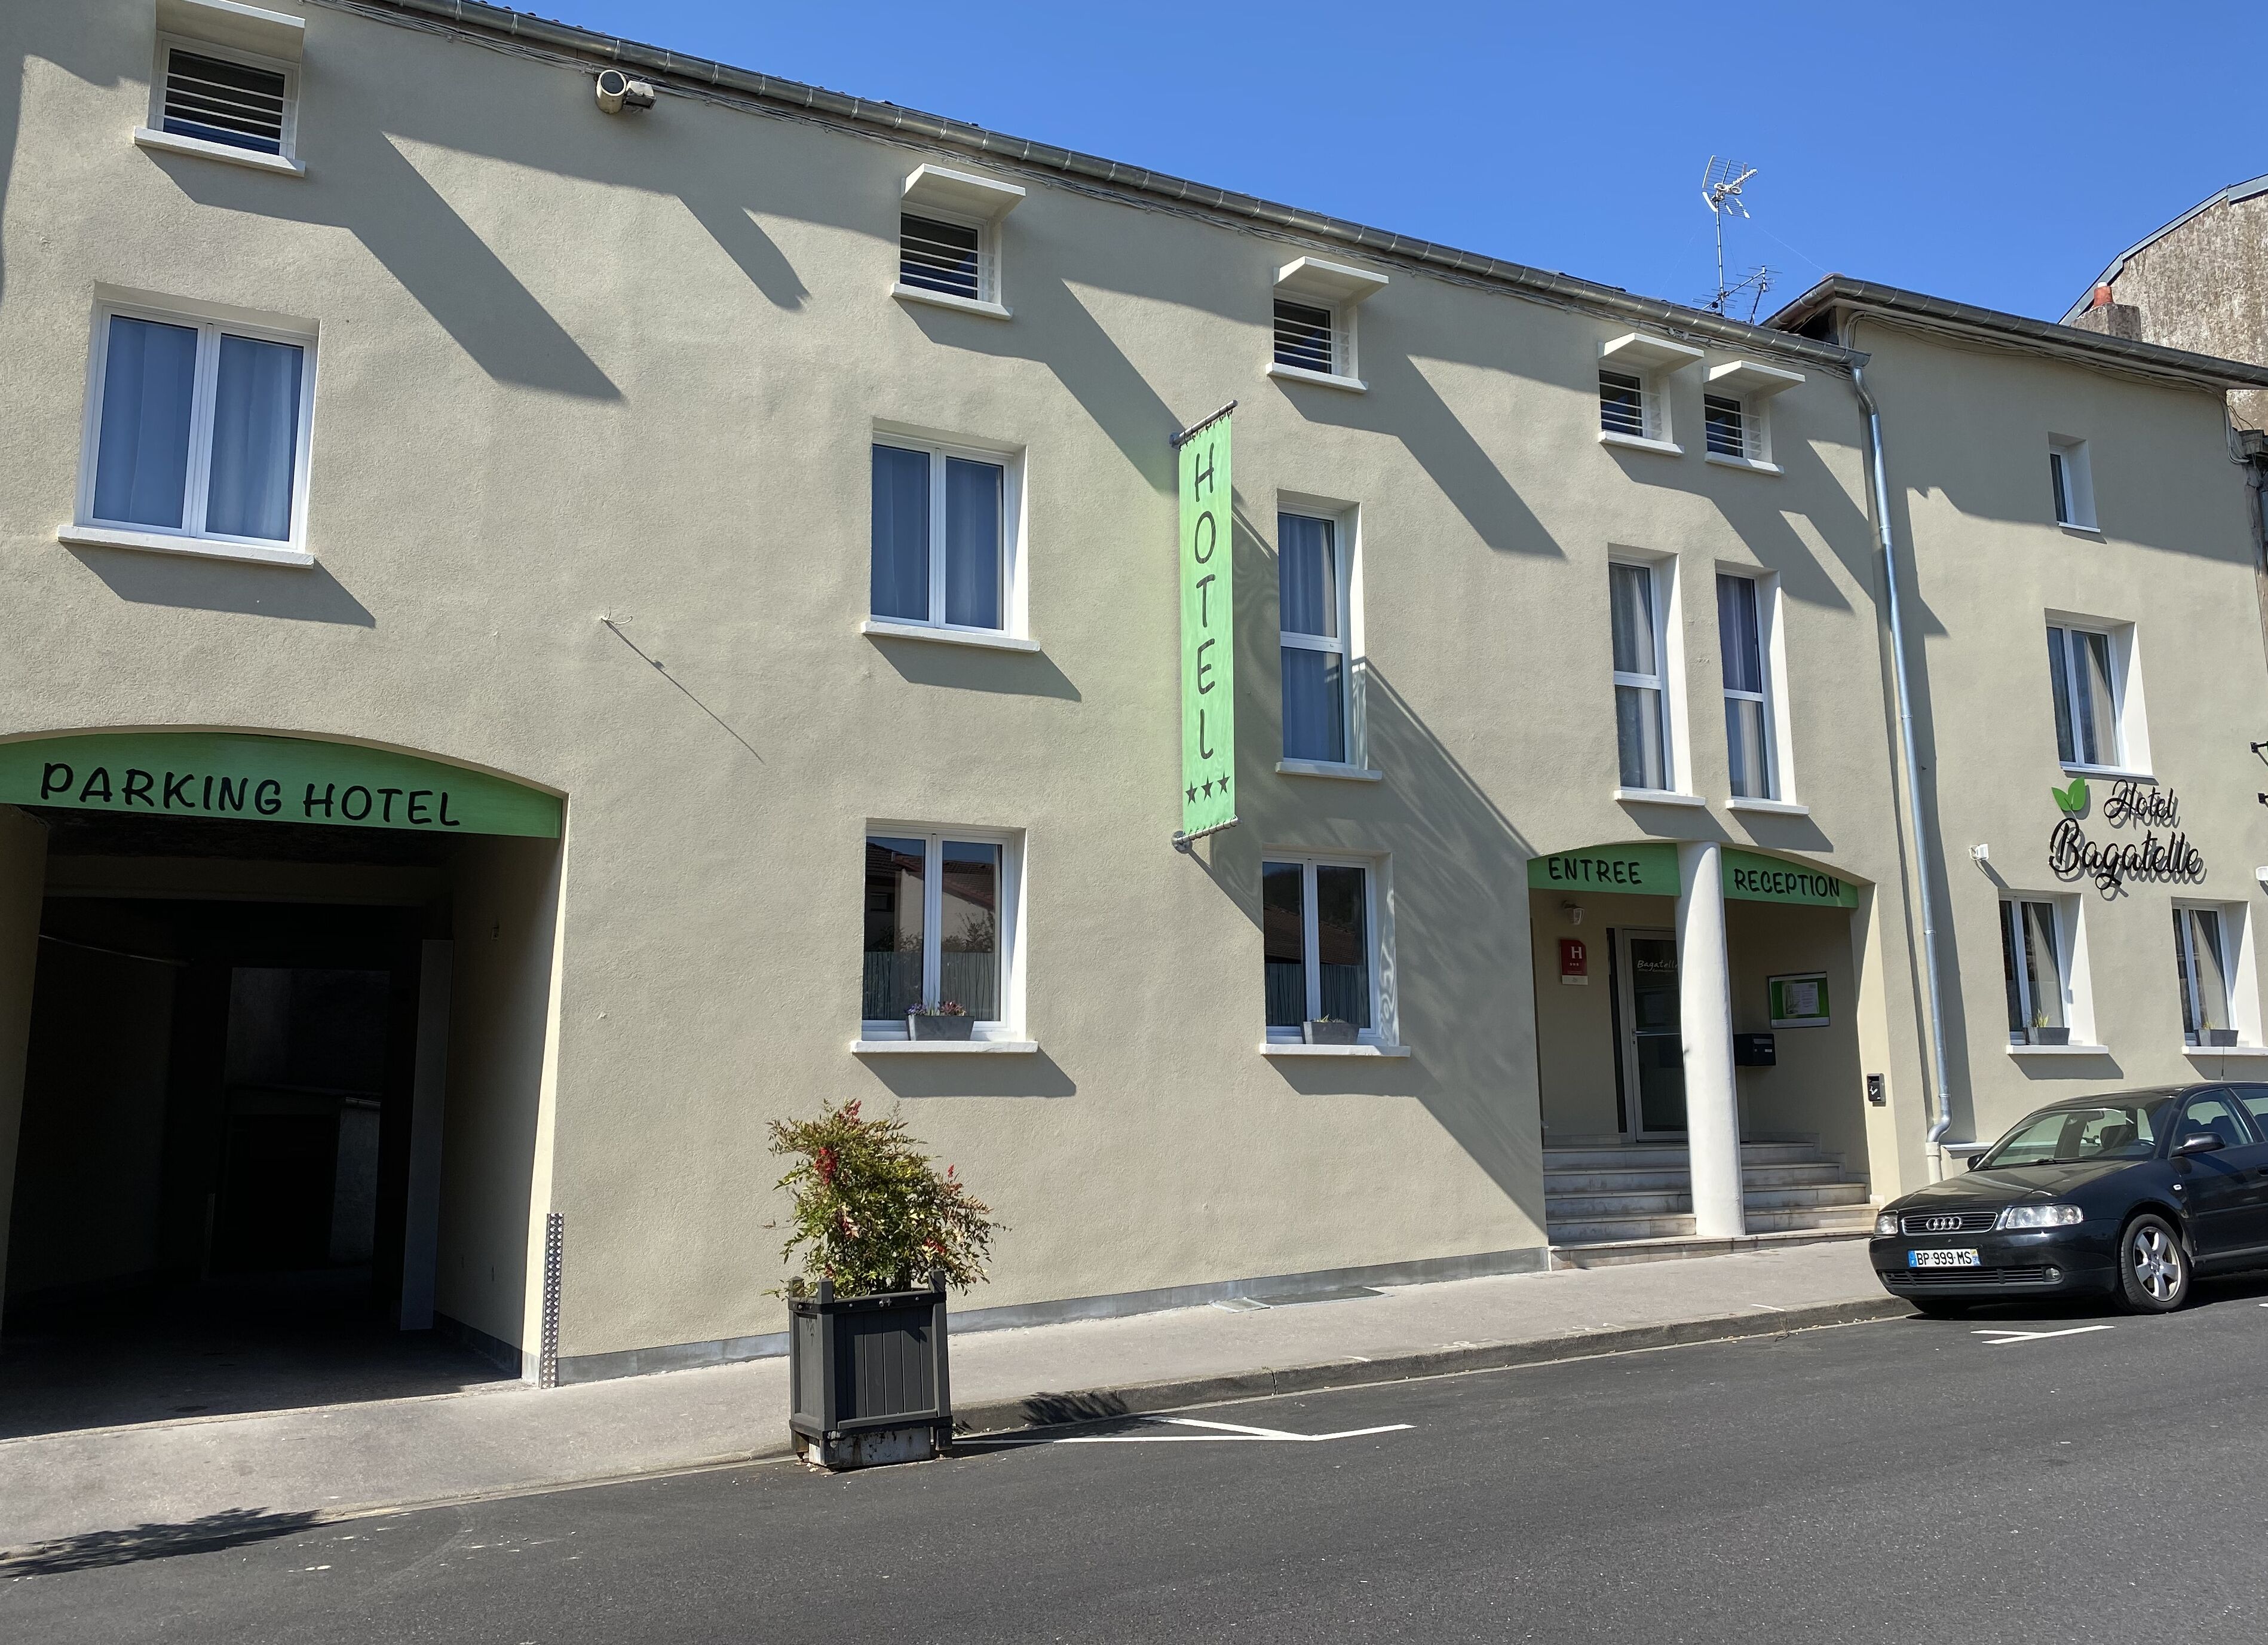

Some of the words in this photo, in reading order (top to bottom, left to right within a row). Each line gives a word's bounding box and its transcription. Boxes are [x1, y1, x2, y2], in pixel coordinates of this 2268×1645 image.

[1194, 442, 1216, 759] HOTEL
[40, 762, 283, 816] PARKING
[302, 783, 461, 826] HOTEL
[2103, 779, 2175, 820] Hotel
[1548, 856, 1642, 884] ENTREE
[2048, 817, 2202, 890] Bagatelle
[1734, 868, 1840, 897] RECEPTION
[1570, 946, 1583, 959] H
